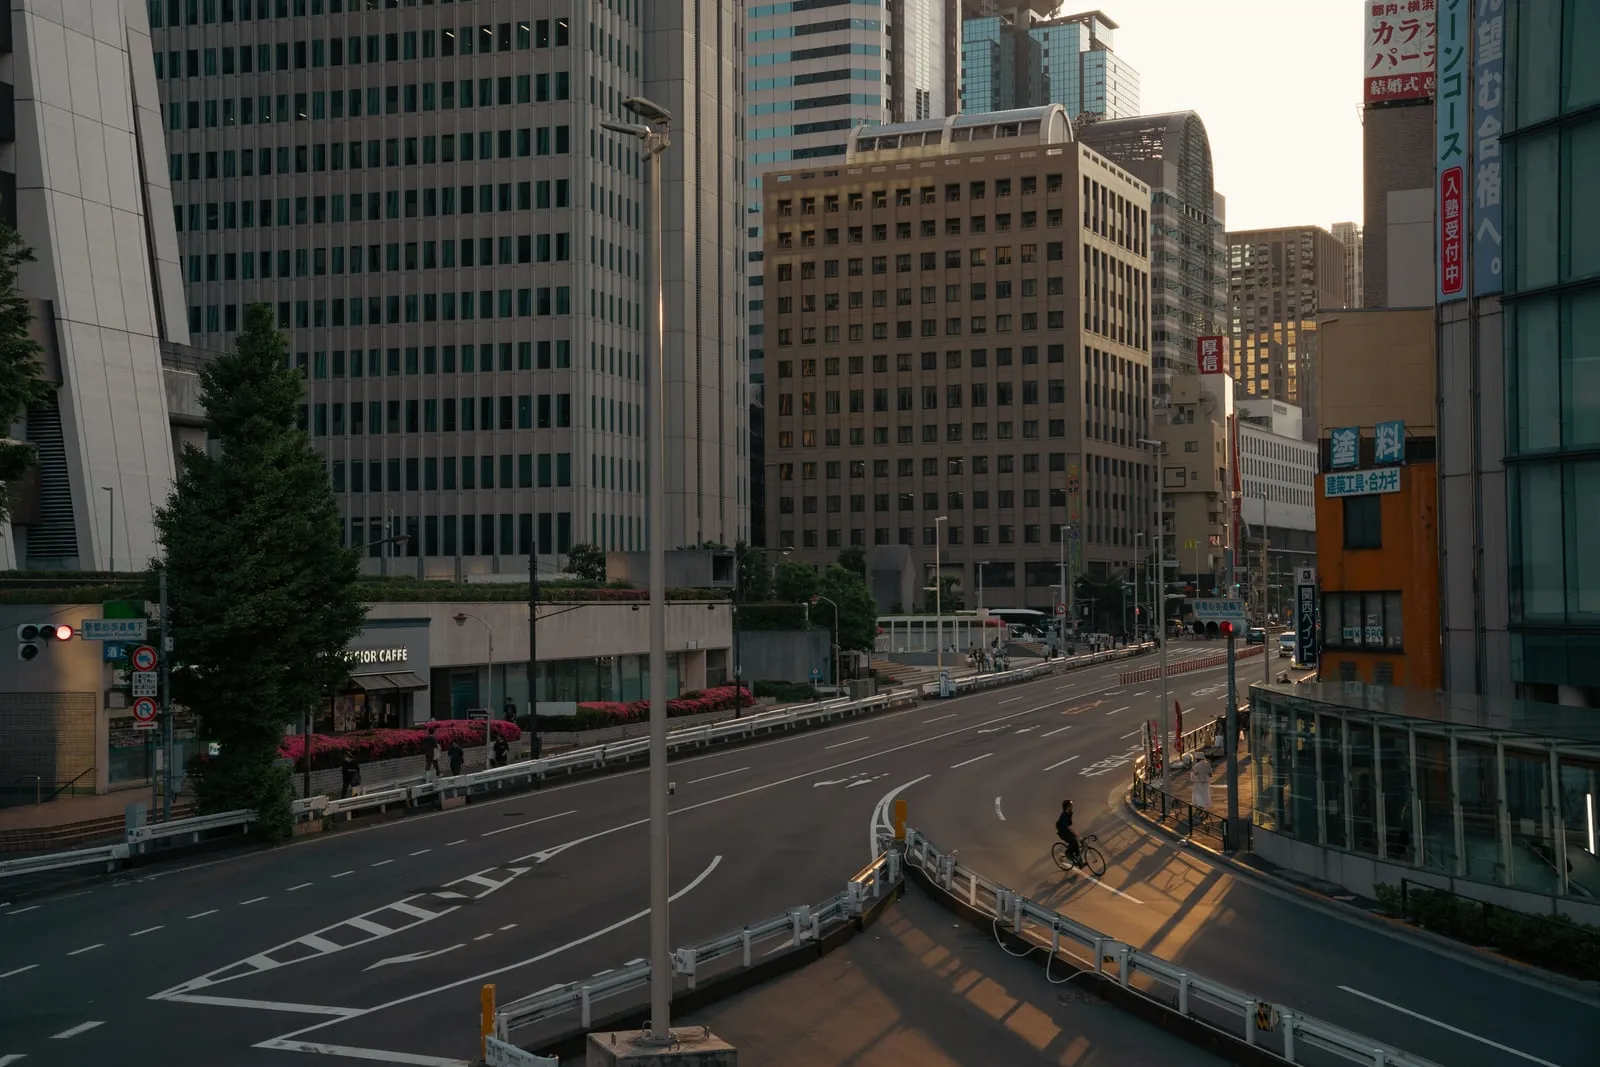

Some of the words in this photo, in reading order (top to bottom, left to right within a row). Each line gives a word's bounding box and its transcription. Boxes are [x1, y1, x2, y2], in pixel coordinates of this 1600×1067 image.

[1372, 0, 1434, 17] 都内・横浜
[1441, 0, 1464, 161] ーンコース
[1445, 176, 1459, 285] 入塾受付中
[1202, 339, 1218, 371] 厚信
[1301, 587, 1313, 661] 関西ペイント
